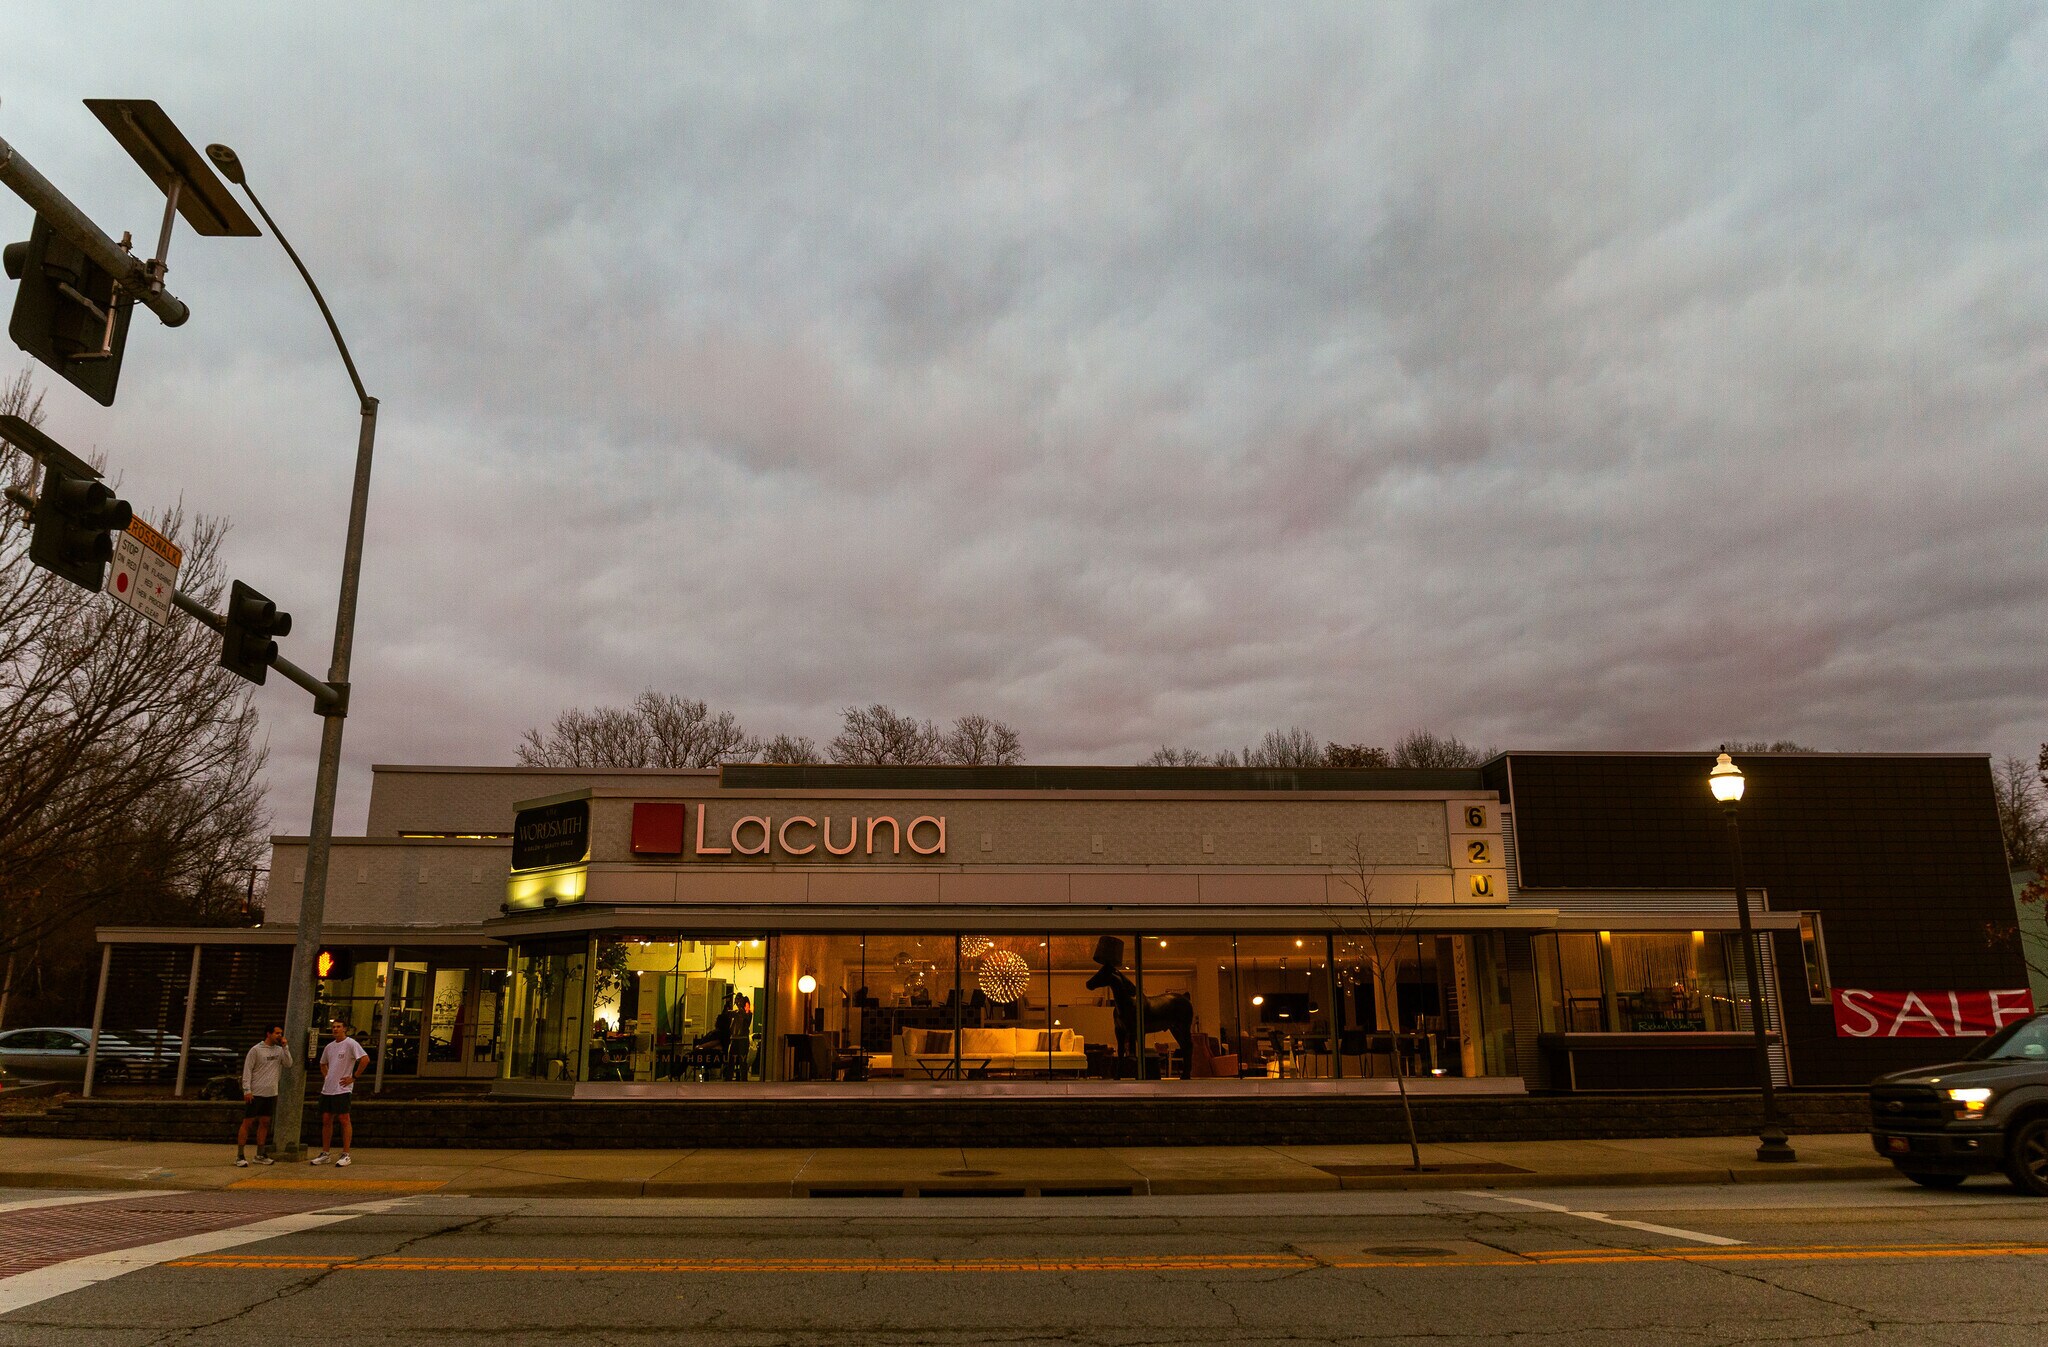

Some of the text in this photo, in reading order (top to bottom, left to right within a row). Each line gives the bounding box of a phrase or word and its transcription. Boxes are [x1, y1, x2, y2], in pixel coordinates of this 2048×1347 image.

[122, 539, 139, 556] STOP
[127, 519, 179, 565] ROSSWALK
[126, 558, 137, 571] RED
[144, 606, 159, 618] CLEAR
[519, 816, 582, 840] WORDSMITH
[696, 803, 946, 855] Lacuna
